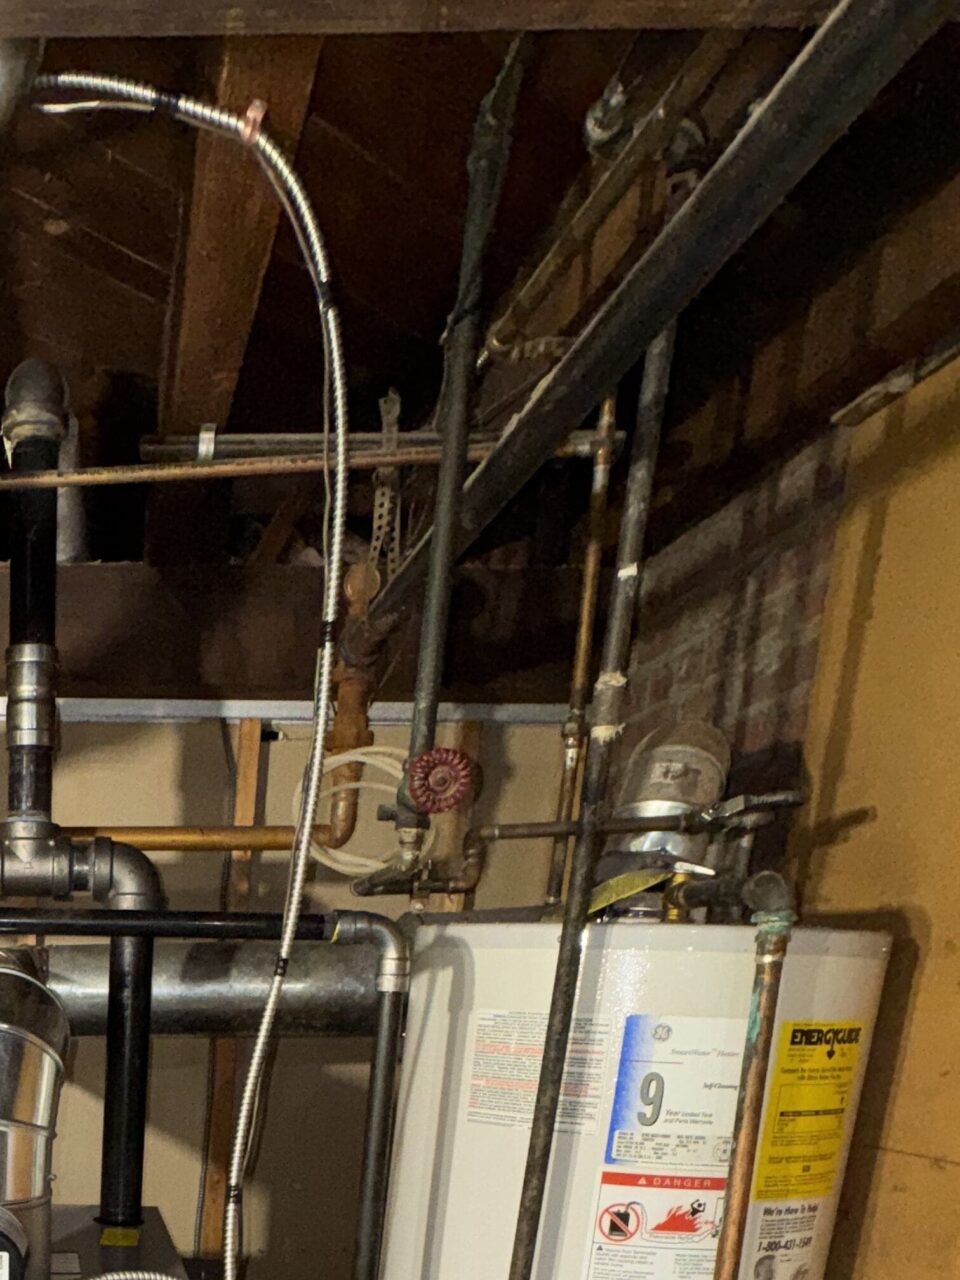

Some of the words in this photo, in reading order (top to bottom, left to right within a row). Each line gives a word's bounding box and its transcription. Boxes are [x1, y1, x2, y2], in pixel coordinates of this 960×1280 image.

[637, 1072, 665, 1126] 9
[665, 1109, 680, 1117] Year
[653, 1179, 711, 1187] DANGER
